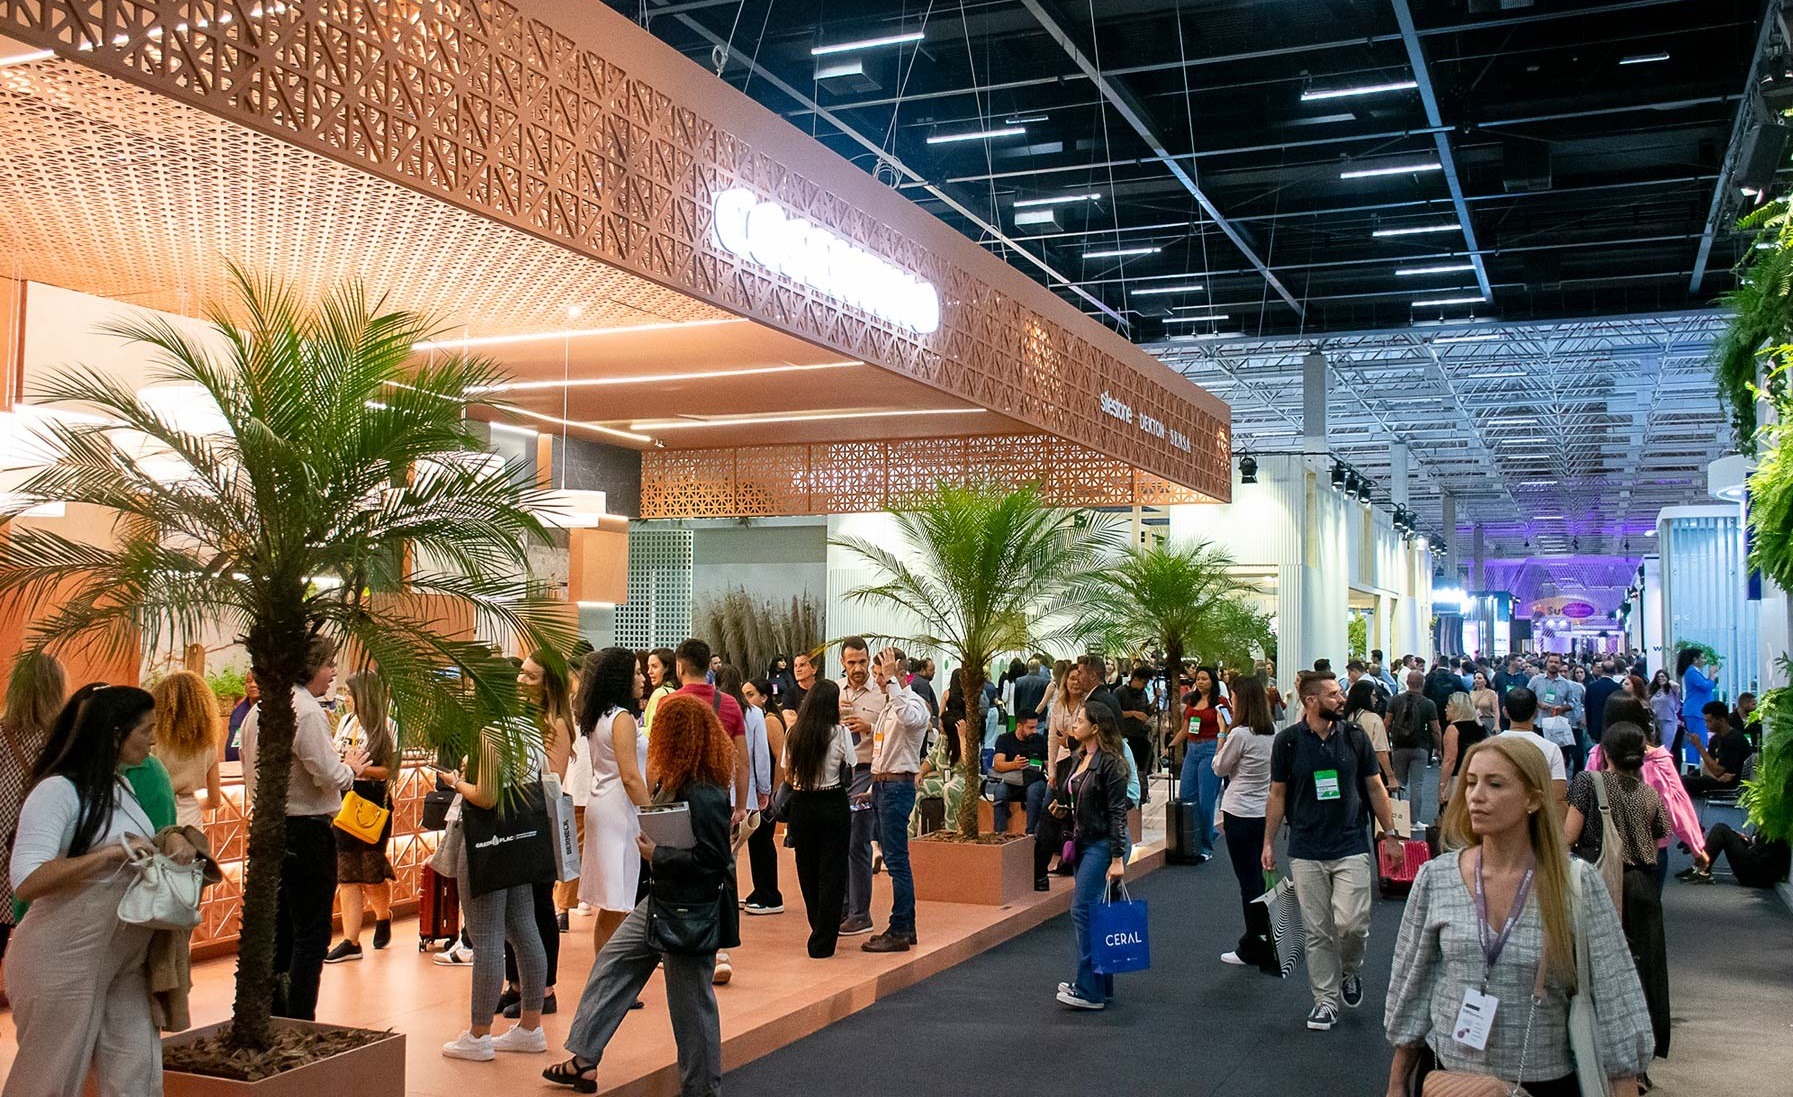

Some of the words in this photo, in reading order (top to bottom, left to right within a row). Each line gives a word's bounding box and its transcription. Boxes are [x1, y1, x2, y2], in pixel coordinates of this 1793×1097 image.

[1139, 413, 1165, 439] DEKTON
[1170, 428, 1191, 453] SENSA
[1105, 931, 1142, 947] CERAL
